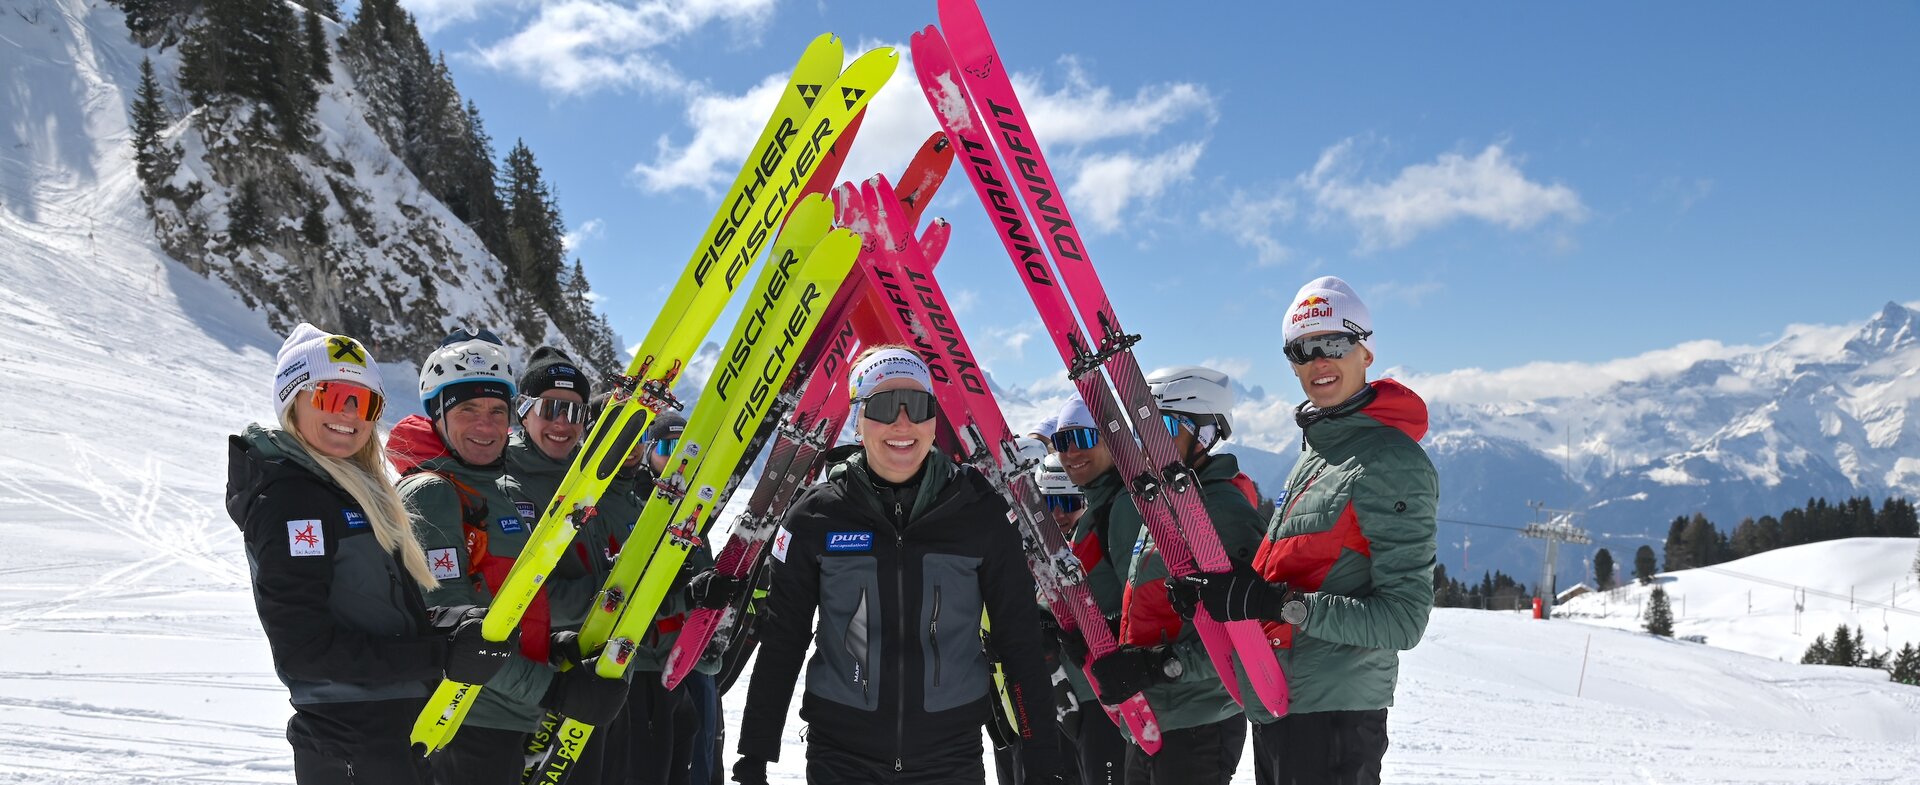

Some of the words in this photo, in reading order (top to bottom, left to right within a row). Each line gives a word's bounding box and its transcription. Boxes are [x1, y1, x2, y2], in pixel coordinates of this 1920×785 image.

[694, 117, 799, 288] FISCHER
[725, 117, 834, 293] FISCHER
[959, 134, 1053, 287] DYNAFIT
[986, 98, 1083, 262] DYNAFIT
[716, 249, 800, 402] FISCHER
[733, 282, 821, 443] FISCHER
[904, 266, 985, 395] DYNAFIT
[1292, 309, 1310, 324] Red
[1311, 308, 1333, 317] Bull
[830, 534, 870, 544] pure
